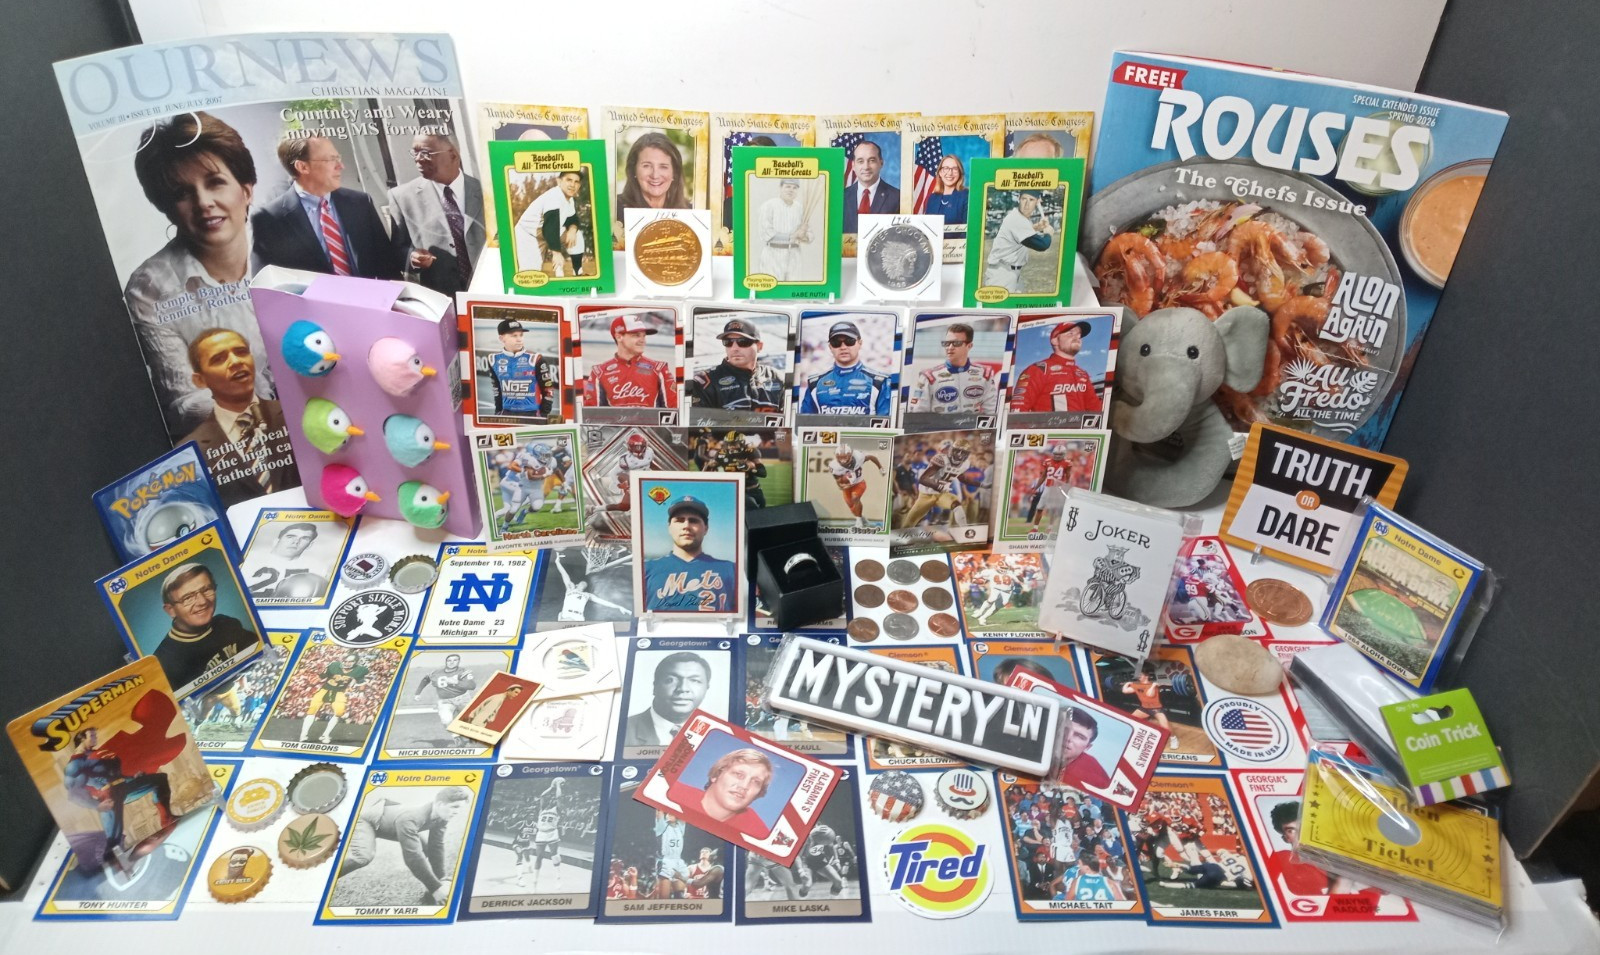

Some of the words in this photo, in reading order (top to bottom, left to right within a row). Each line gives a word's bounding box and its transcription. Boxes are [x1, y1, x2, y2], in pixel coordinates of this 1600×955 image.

[1124, 65, 1177, 89] FREE!
[311, 86, 380, 97] CHRISTIAN
[383, 86, 449, 97] MAGAZINE
[88, 115, 115, 130] VOLUME
[131, 107, 153, 118] ISSUE
[206, 96, 223, 105] 2007
[1352, 94, 1380, 108] SPECIAL
[1382, 99, 1418, 113] EXTENDED
[1418, 104, 1441, 118] ISSUE
[279, 107, 360, 124] Courtney
[364, 106, 394, 120] and
[398, 107, 453, 123] Weary
[486, 108, 515, 119] United
[516, 110, 543, 121] States
[544, 110, 582, 124] Congress
[609, 111, 638, 122] United
[640, 112, 666, 124] States
[667, 114, 704, 127] Congress
[1387, 111, 1414, 123] SPRING
[1415, 115, 1436, 127] 2026
[287, 124, 347, 140] moving
[351, 122, 380, 136] MS
[385, 121, 449, 137] forward
[907, 122, 935, 132] United
[937, 121, 963, 131] States
[963, 120, 999, 133] Congress
[1151, 87, 1430, 191] ROUSES
[531, 154, 564, 162] Baseball's
[552, 161, 574, 170] Greats
[1012, 171, 1044, 180] Baseball's
[1030, 179, 1052, 188] Greats
[1175, 167, 1217, 189] The
[1224, 177, 1297, 203] Chefs
[1302, 190, 1368, 216] Issue
[153, 292, 195, 313] Temple
[199, 282, 236, 299] Baptist
[156, 304, 203, 326] Jennifer
[612, 381, 649, 401] Lilly
[1053, 384, 1087, 395] BRAND
[1280, 379, 1371, 413] Fredo
[821, 405, 868, 415] FASTENAL
[1294, 409, 1311, 418] ALL
[1313, 410, 1331, 419] THE
[1335, 411, 1361, 421] TIME
[206, 438, 249, 460] father
[217, 456, 239, 473] the
[241, 446, 272, 468] high
[216, 455, 294, 486] fatherhood
[1045, 466, 1063, 479] 24
[1271, 442, 1372, 499] TRUTH
[1300, 495, 1315, 507] OR
[503, 530, 531, 541] North
[1256, 504, 1341, 556] DARE
[494, 542, 523, 551] JAVONTE
[523, 540, 553, 549] WILLIAMS
[1393, 534, 1417, 551] Notre
[1417, 547, 1442, 566] Dame
[134, 562, 161, 580] Notre
[163, 547, 189, 565] Dame
[449, 560, 490, 568] September
[507, 559, 527, 567] 1982
[657, 570, 723, 598] Mets
[368, 593, 401, 611] SINGLE
[699, 590, 726, 611] 21
[334, 596, 364, 630] SUPPORT
[384, 607, 406, 633] MOMS
[440, 629, 478, 637] Michigan
[659, 639, 709, 648] Georgetown
[1360, 643, 1385, 662] ALOHA
[1385, 656, 1408, 677] BOWL
[192, 672, 210, 688] LOU
[211, 658, 236, 677] HOLTZ
[788, 648, 1005, 746] MYSTERY
[1003, 699, 1042, 741] LN
[44, 674, 145, 752] SUPERMAN
[1219, 702, 1261, 712] PROUDLY
[1130, 727, 1144, 751] FINEST
[1405, 731, 1443, 752] Coin
[1441, 722, 1482, 744] Trick
[300, 743, 339, 752] GIBBONS
[398, 749, 418, 757] NICK
[421, 748, 476, 757] BUONICONTI
[1134, 732, 1156, 769] ALABAMA'S
[1225, 741, 1252, 757] MADE
[1254, 750, 1265, 758] IN
[1264, 744, 1281, 757] USA
[888, 758, 917, 766] CHUCK
[395, 774, 422, 782] Notre
[423, 774, 451, 783] Dame
[522, 766, 577, 775] Georgetown
[801, 768, 817, 793] FINEST
[1151, 781, 1188, 789] Clemson
[1246, 775, 1288, 784] GEORGIA'S
[801, 771, 830, 813] ALABAMA'S
[1249, 784, 1276, 792] FINEST
[1363, 836, 1437, 873] Ticket
[888, 839, 986, 891] Tired
[1080, 887, 1106, 900] 24
[79, 901, 104, 909] TONY
[106, 901, 149, 909] HUNTER
[393, 907, 419, 915] YARR
[481, 899, 525, 908] DERRICK
[526, 898, 573, 907] JACKSON
[647, 903, 703, 911] JEFFERSON
[772, 905, 797, 913] MIKE
[799, 904, 830, 912] LASKA
[1048, 902, 1092, 910] MICHAEL
[1179, 909, 1212, 918] JAMES
[1213, 910, 1239, 918] FARR
